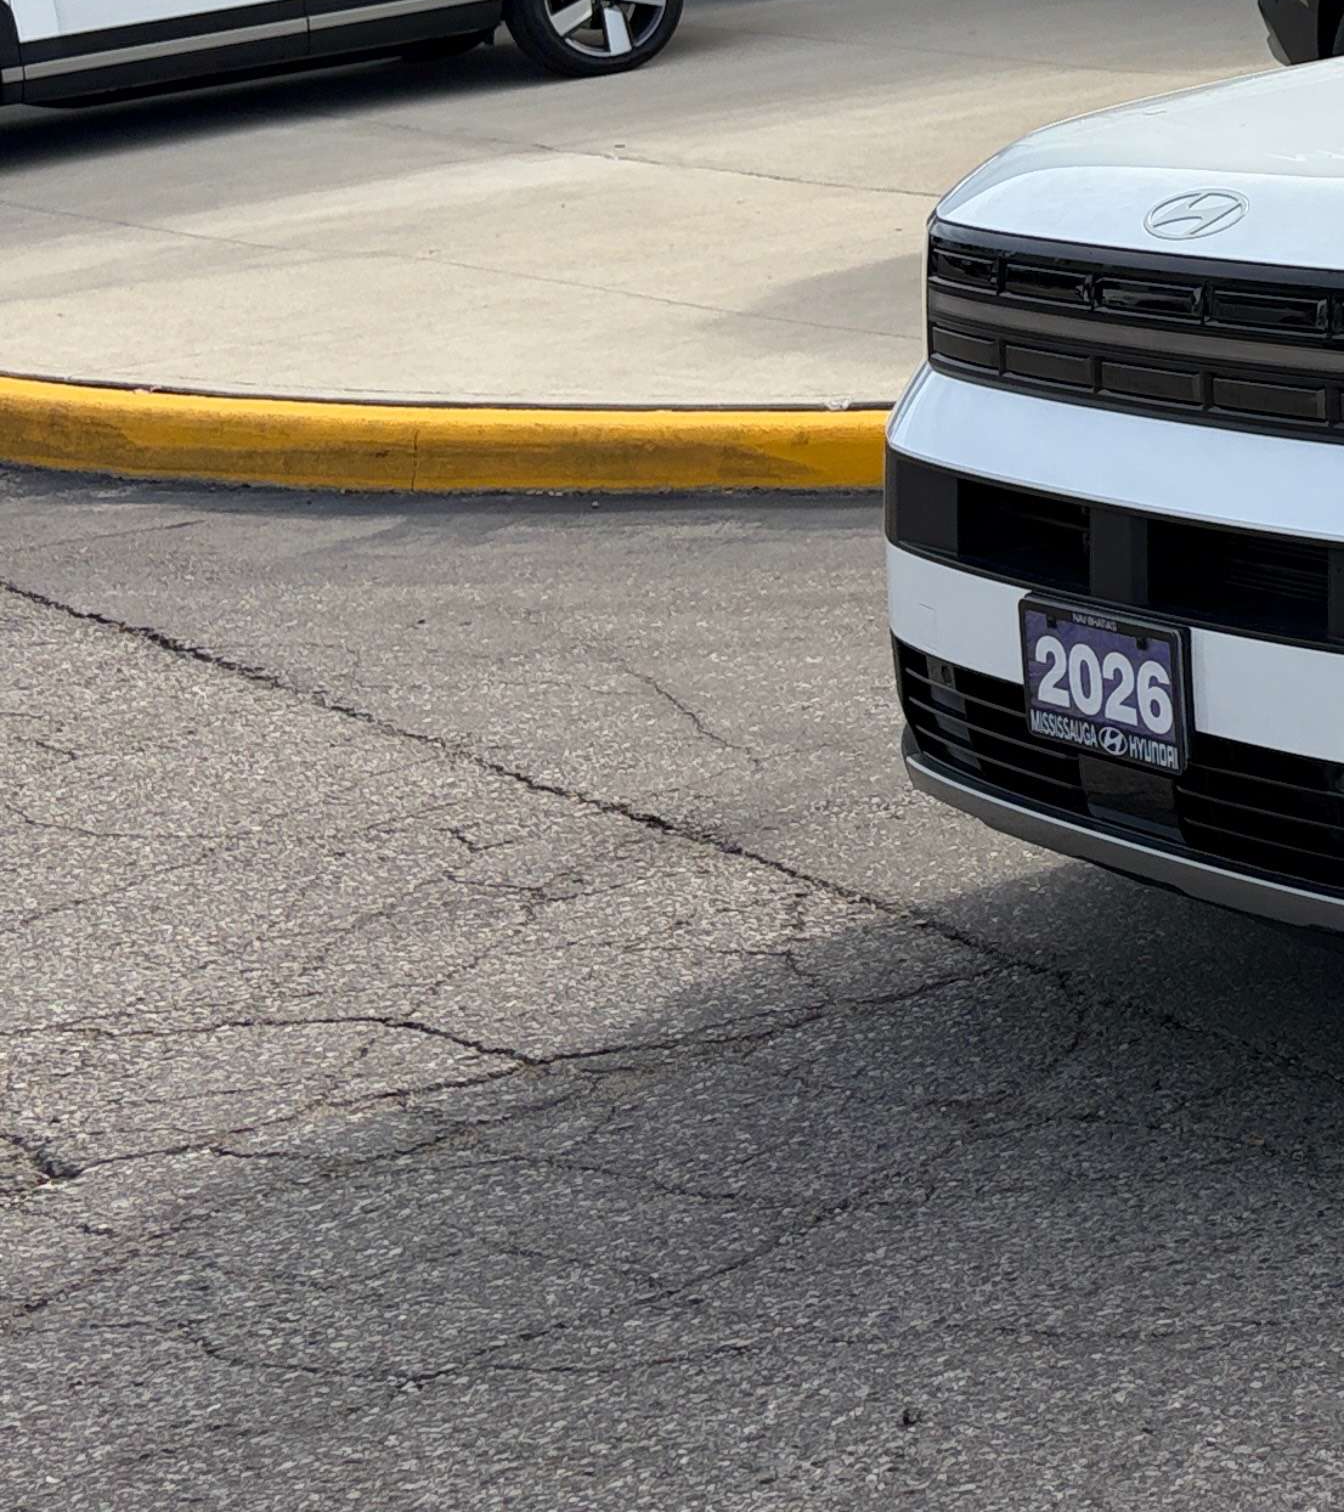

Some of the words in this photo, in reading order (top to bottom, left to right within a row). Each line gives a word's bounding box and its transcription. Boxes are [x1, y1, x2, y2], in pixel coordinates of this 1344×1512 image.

[1035, 635, 1173, 735] 2026
[1030, 709, 1099, 748] MISSISSAUGA
[1129, 735, 1180, 770] HYUNDAI
